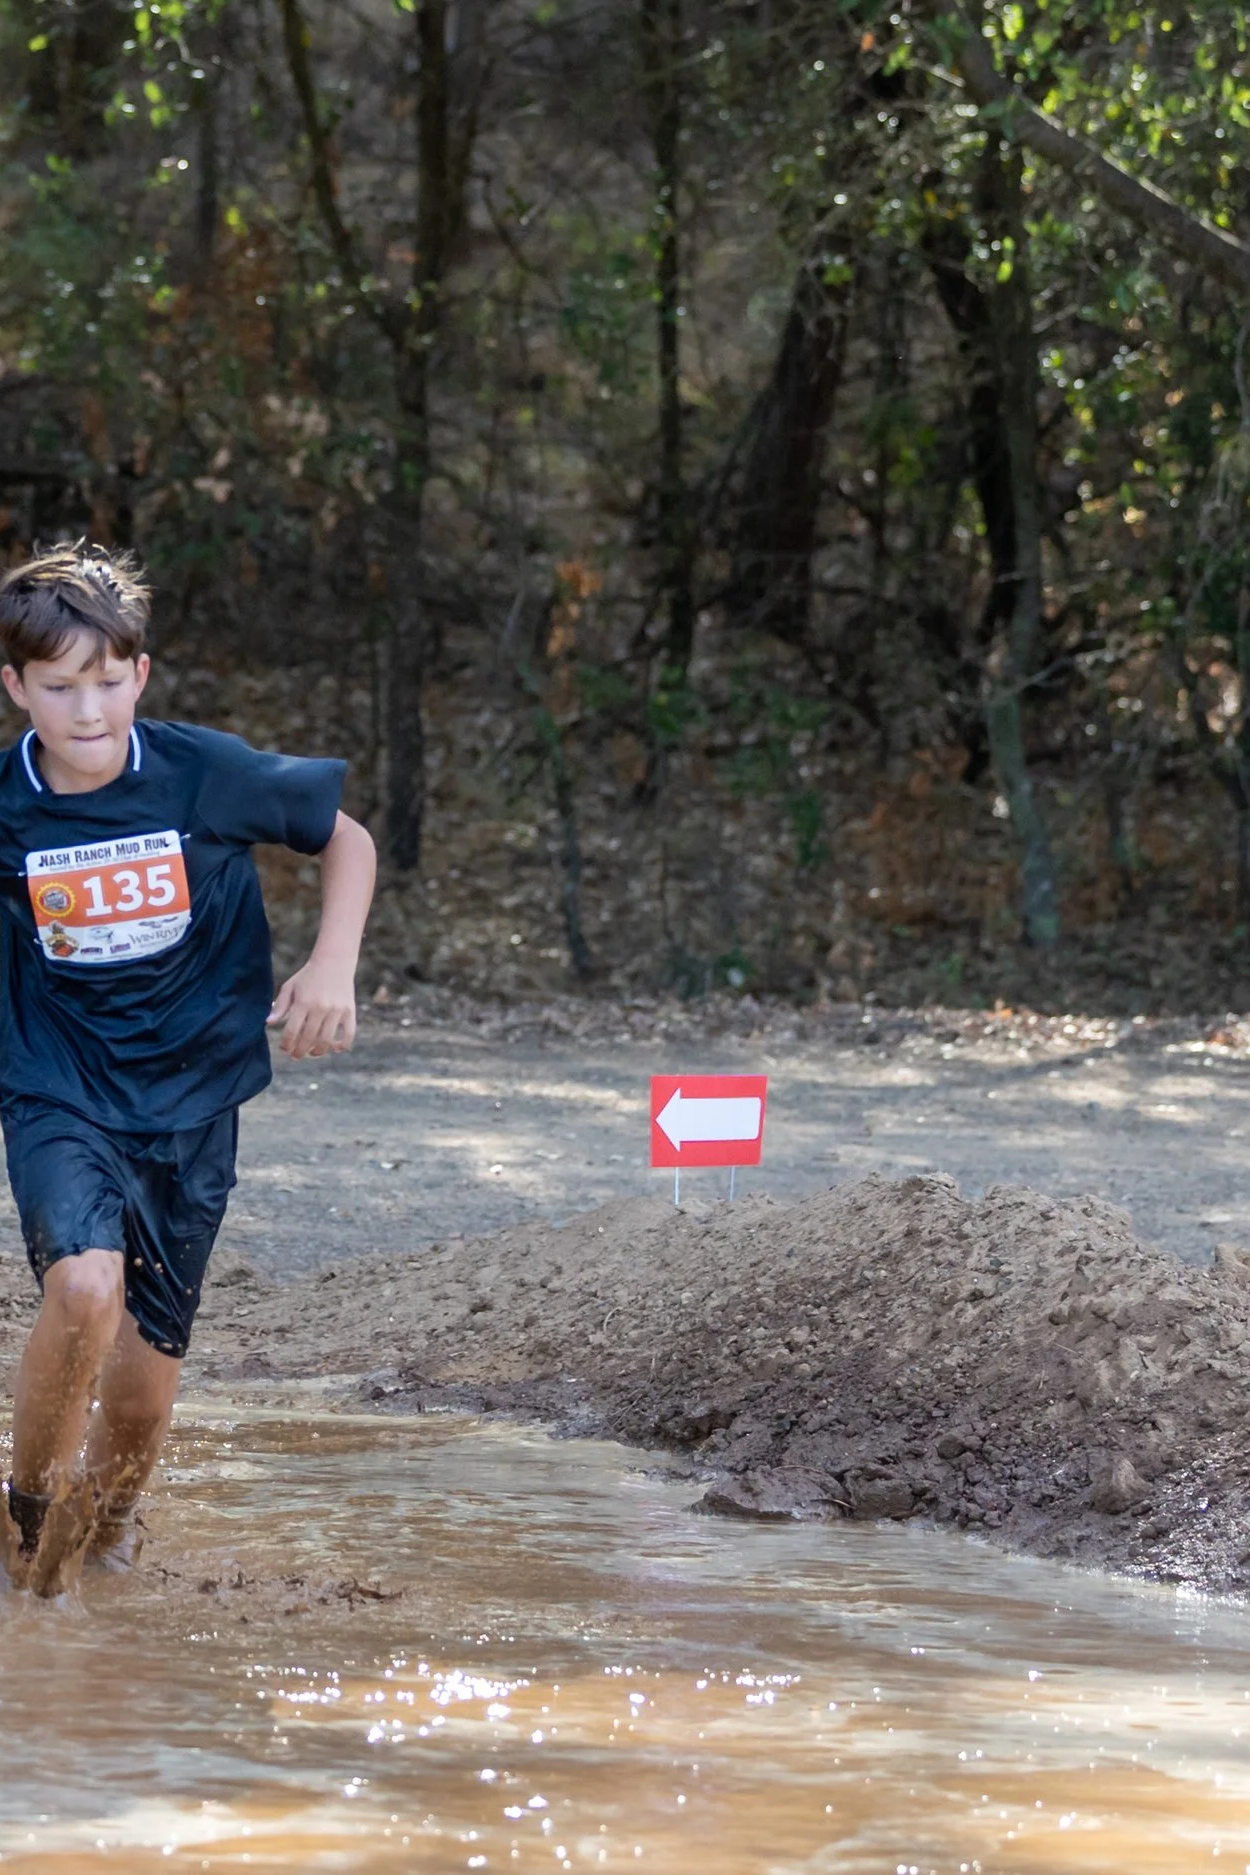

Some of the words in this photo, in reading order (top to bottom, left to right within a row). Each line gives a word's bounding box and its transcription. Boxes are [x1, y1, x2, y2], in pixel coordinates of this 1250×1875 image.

[40, 853, 70, 867] NASH
[74, 846, 111, 863] RANCH
[115, 841, 140, 856] MUD
[144, 837, 167, 851] RUN
[83, 864, 176, 917] 135
